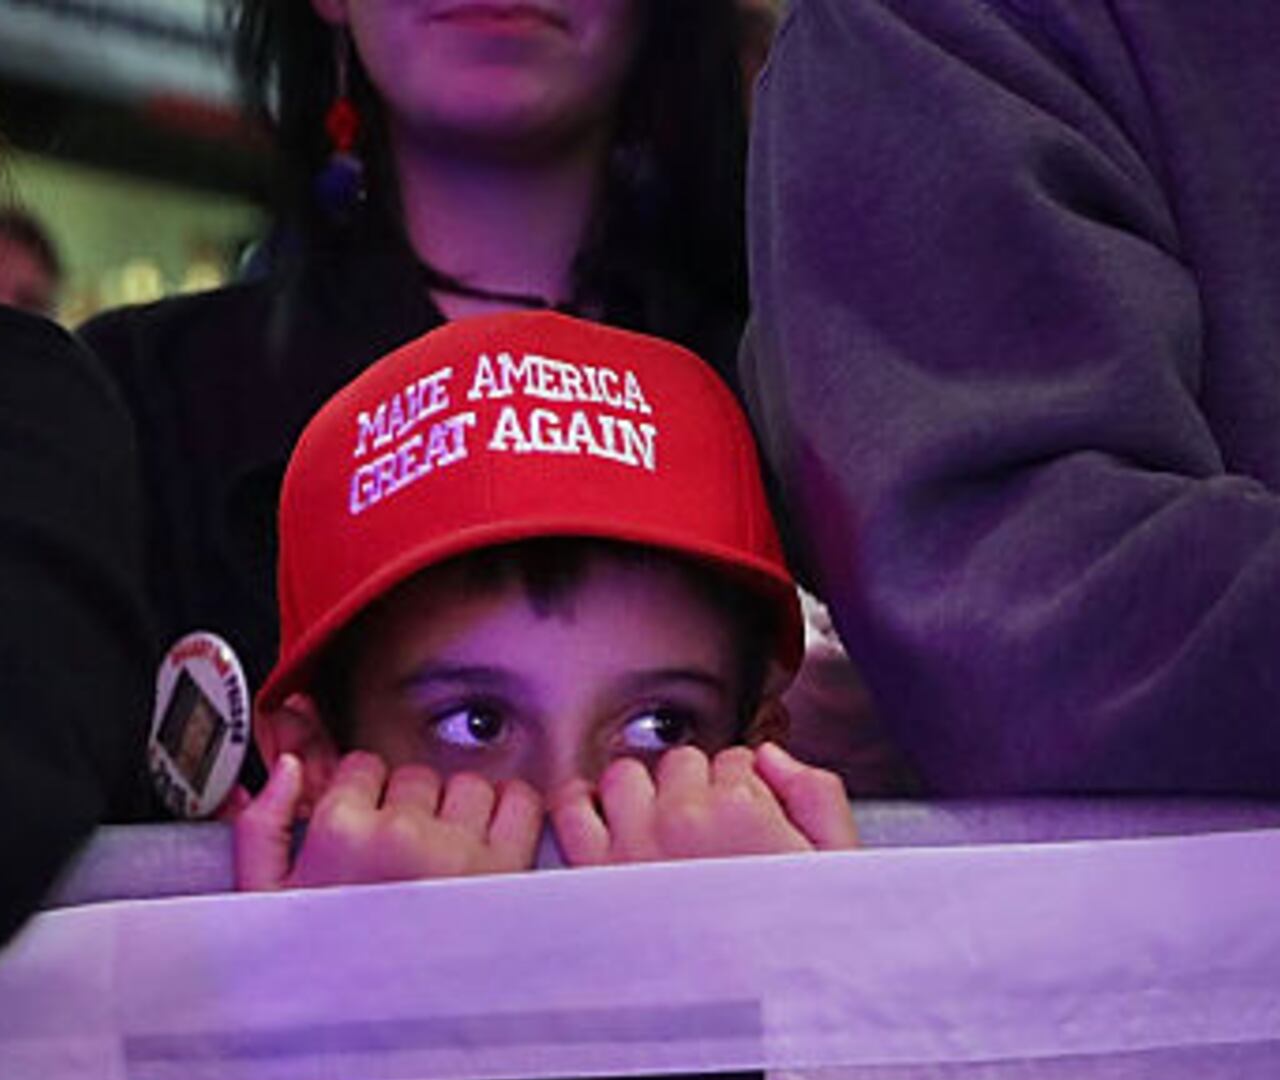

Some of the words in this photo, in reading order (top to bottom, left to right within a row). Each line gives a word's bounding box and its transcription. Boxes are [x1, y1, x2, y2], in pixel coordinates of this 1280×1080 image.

[353, 366, 453, 457] MAKE
[467, 353, 652, 414] AMERICA
[348, 412, 476, 514] GREAT
[487, 405, 658, 472] AGAIN
